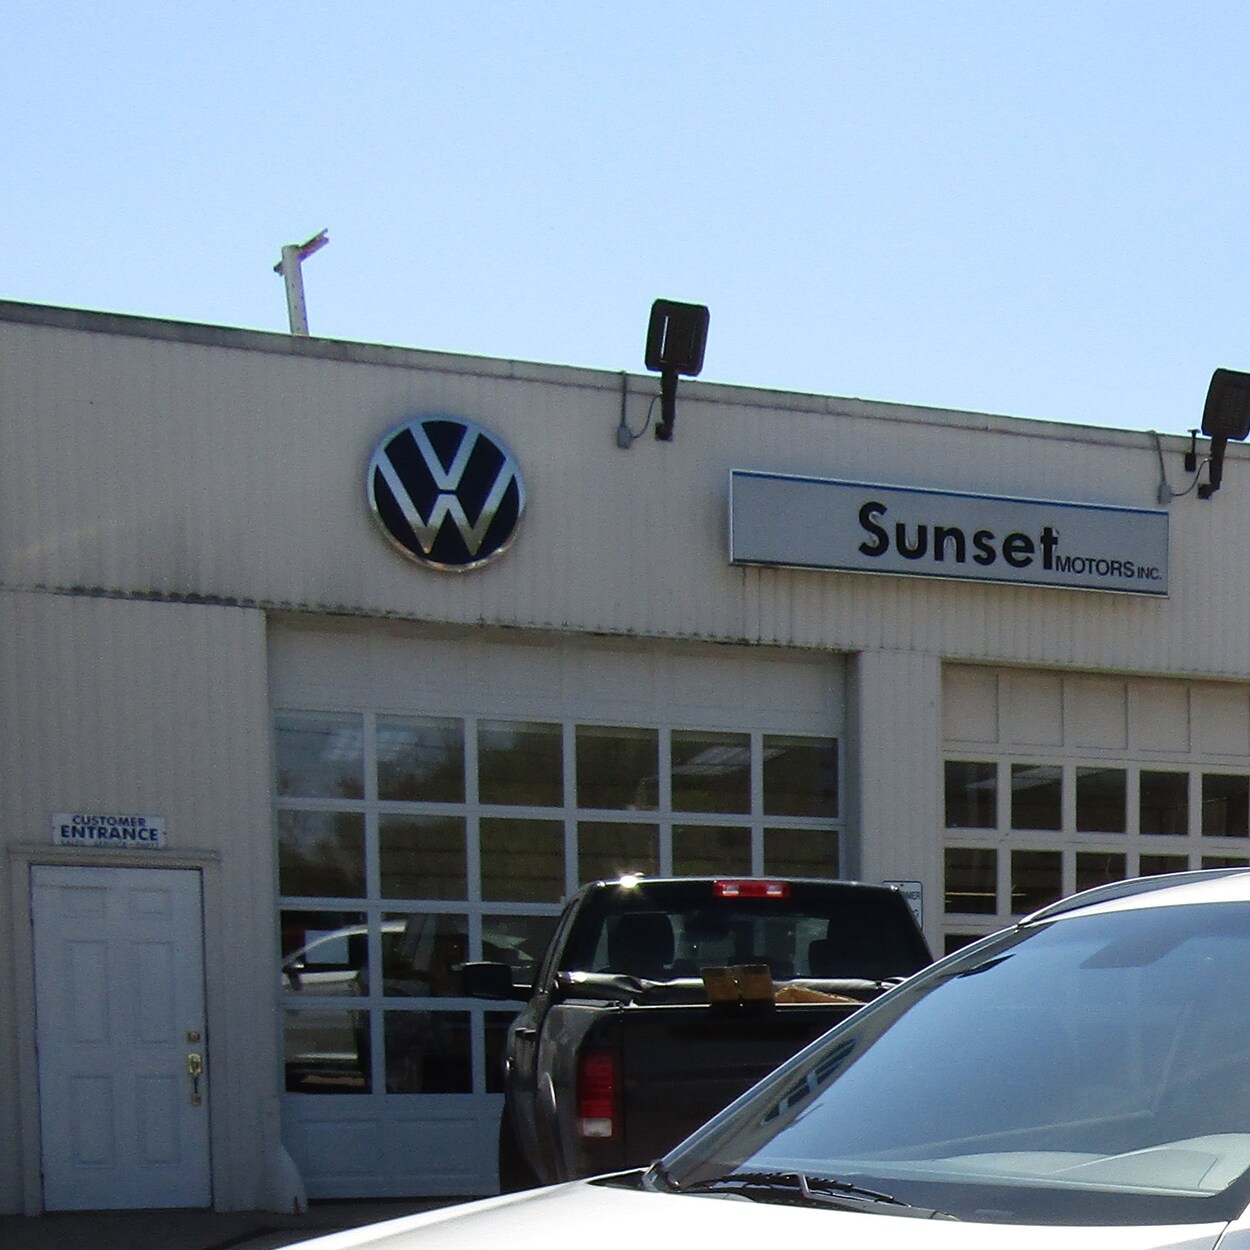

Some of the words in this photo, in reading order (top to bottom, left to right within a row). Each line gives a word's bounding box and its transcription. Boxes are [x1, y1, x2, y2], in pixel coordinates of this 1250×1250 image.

[858, 501, 1059, 570] Sunset
[1055, 557, 1135, 579] MOTORS
[1137, 567, 1163, 581] INC.
[72, 815, 147, 827] CUSTOMER
[60, 825, 159, 841] ENTRANCE
